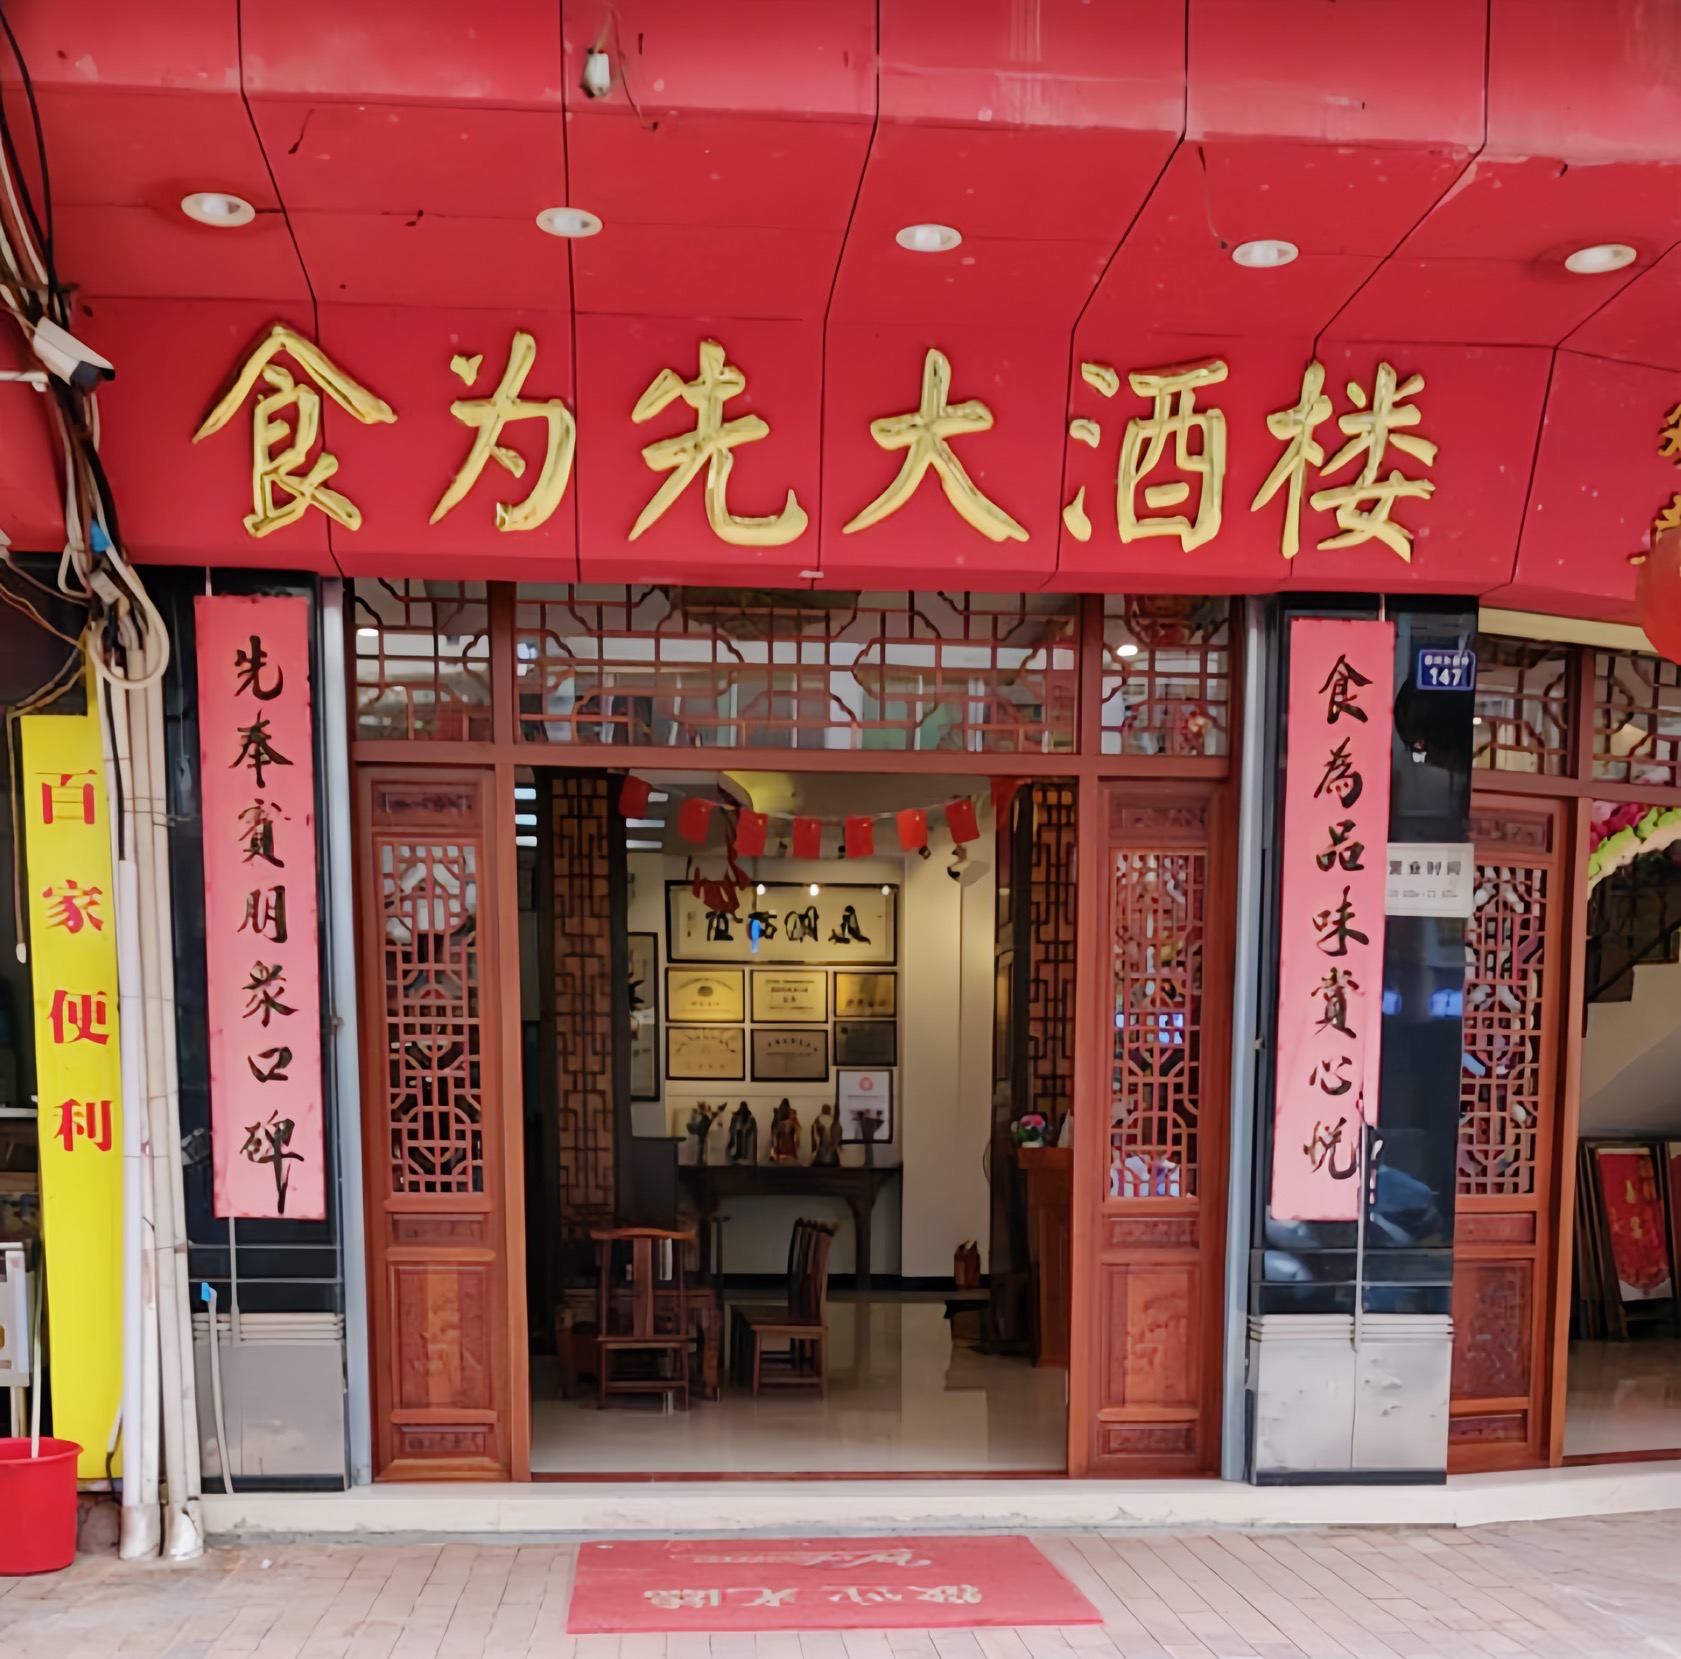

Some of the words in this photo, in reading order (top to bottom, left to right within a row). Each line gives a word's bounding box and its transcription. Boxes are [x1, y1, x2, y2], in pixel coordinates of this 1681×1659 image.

[193, 325, 1438, 562] 食为先大酒楼
[1429, 667, 1462, 686] 147
[36, 769, 112, 1152] 百家便利
